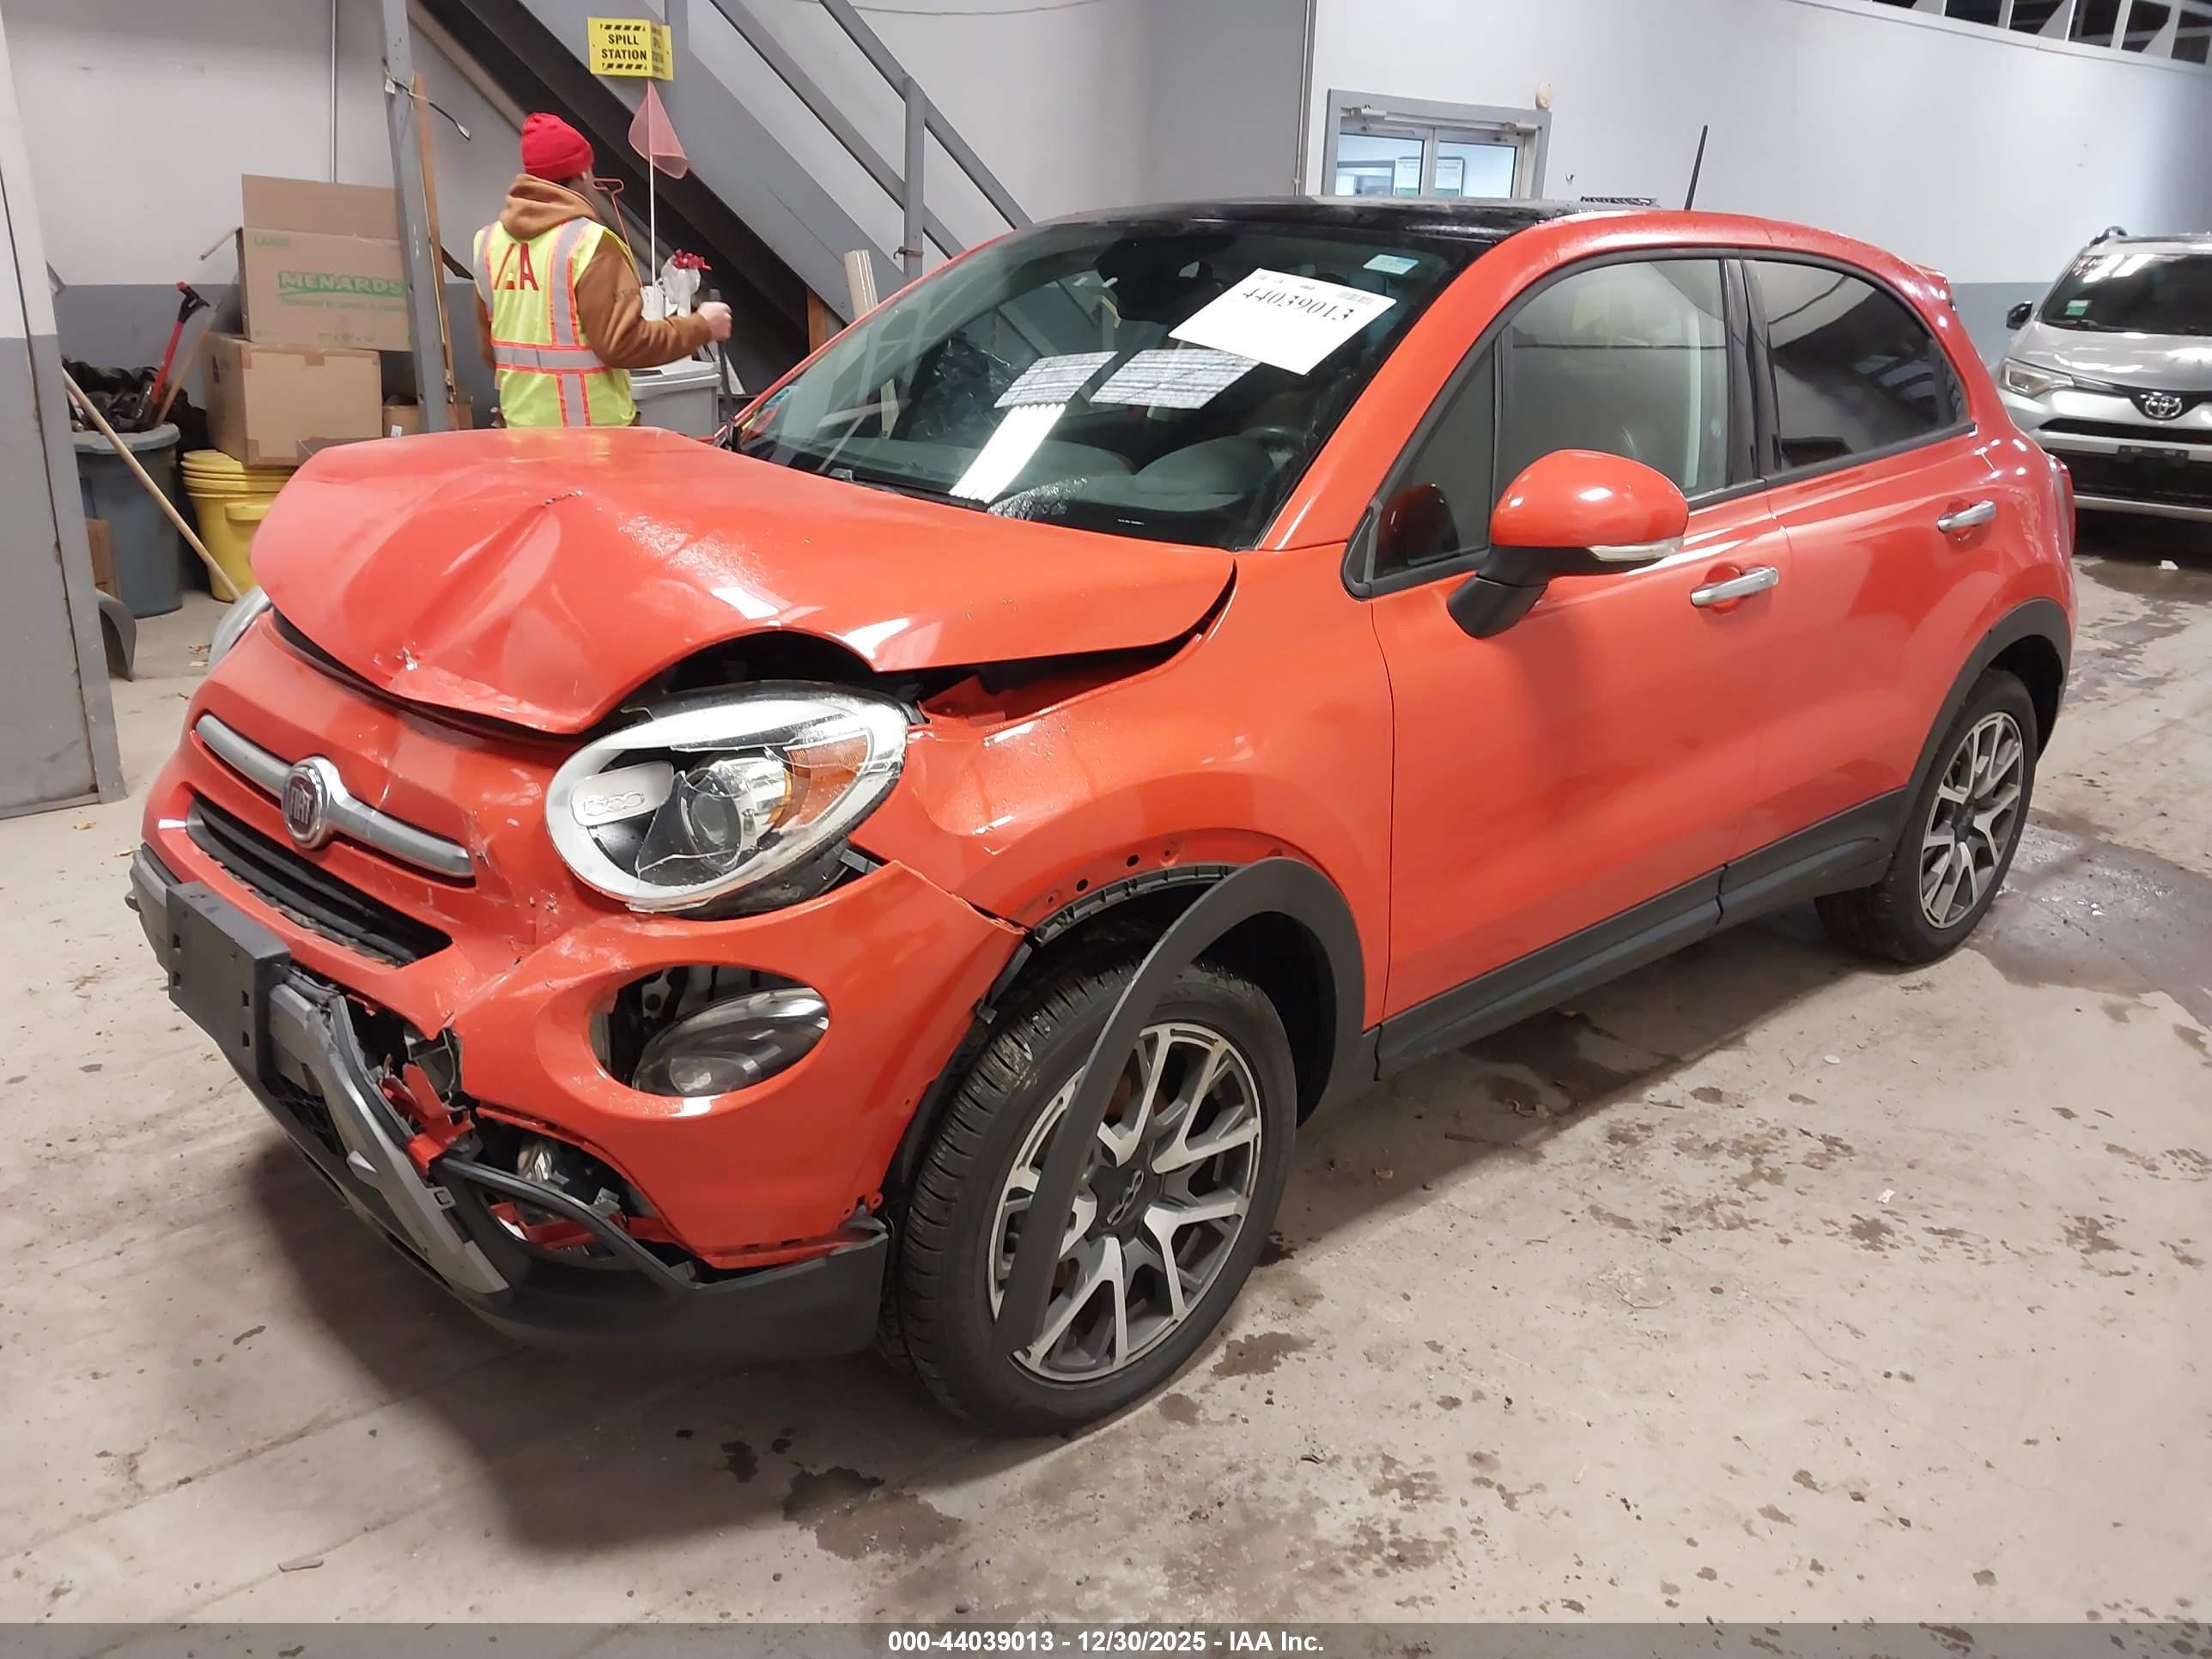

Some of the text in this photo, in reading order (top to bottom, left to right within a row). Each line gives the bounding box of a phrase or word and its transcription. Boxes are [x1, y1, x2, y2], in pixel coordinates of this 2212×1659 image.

[608, 33, 640, 46] SPILL
[601, 48, 647, 61] STATION
[277, 270, 406, 297] MENARDS
[1243, 287, 1355, 321] 44039013
[291, 782, 313, 825] FIAT
[584, 790, 646, 817] 500
